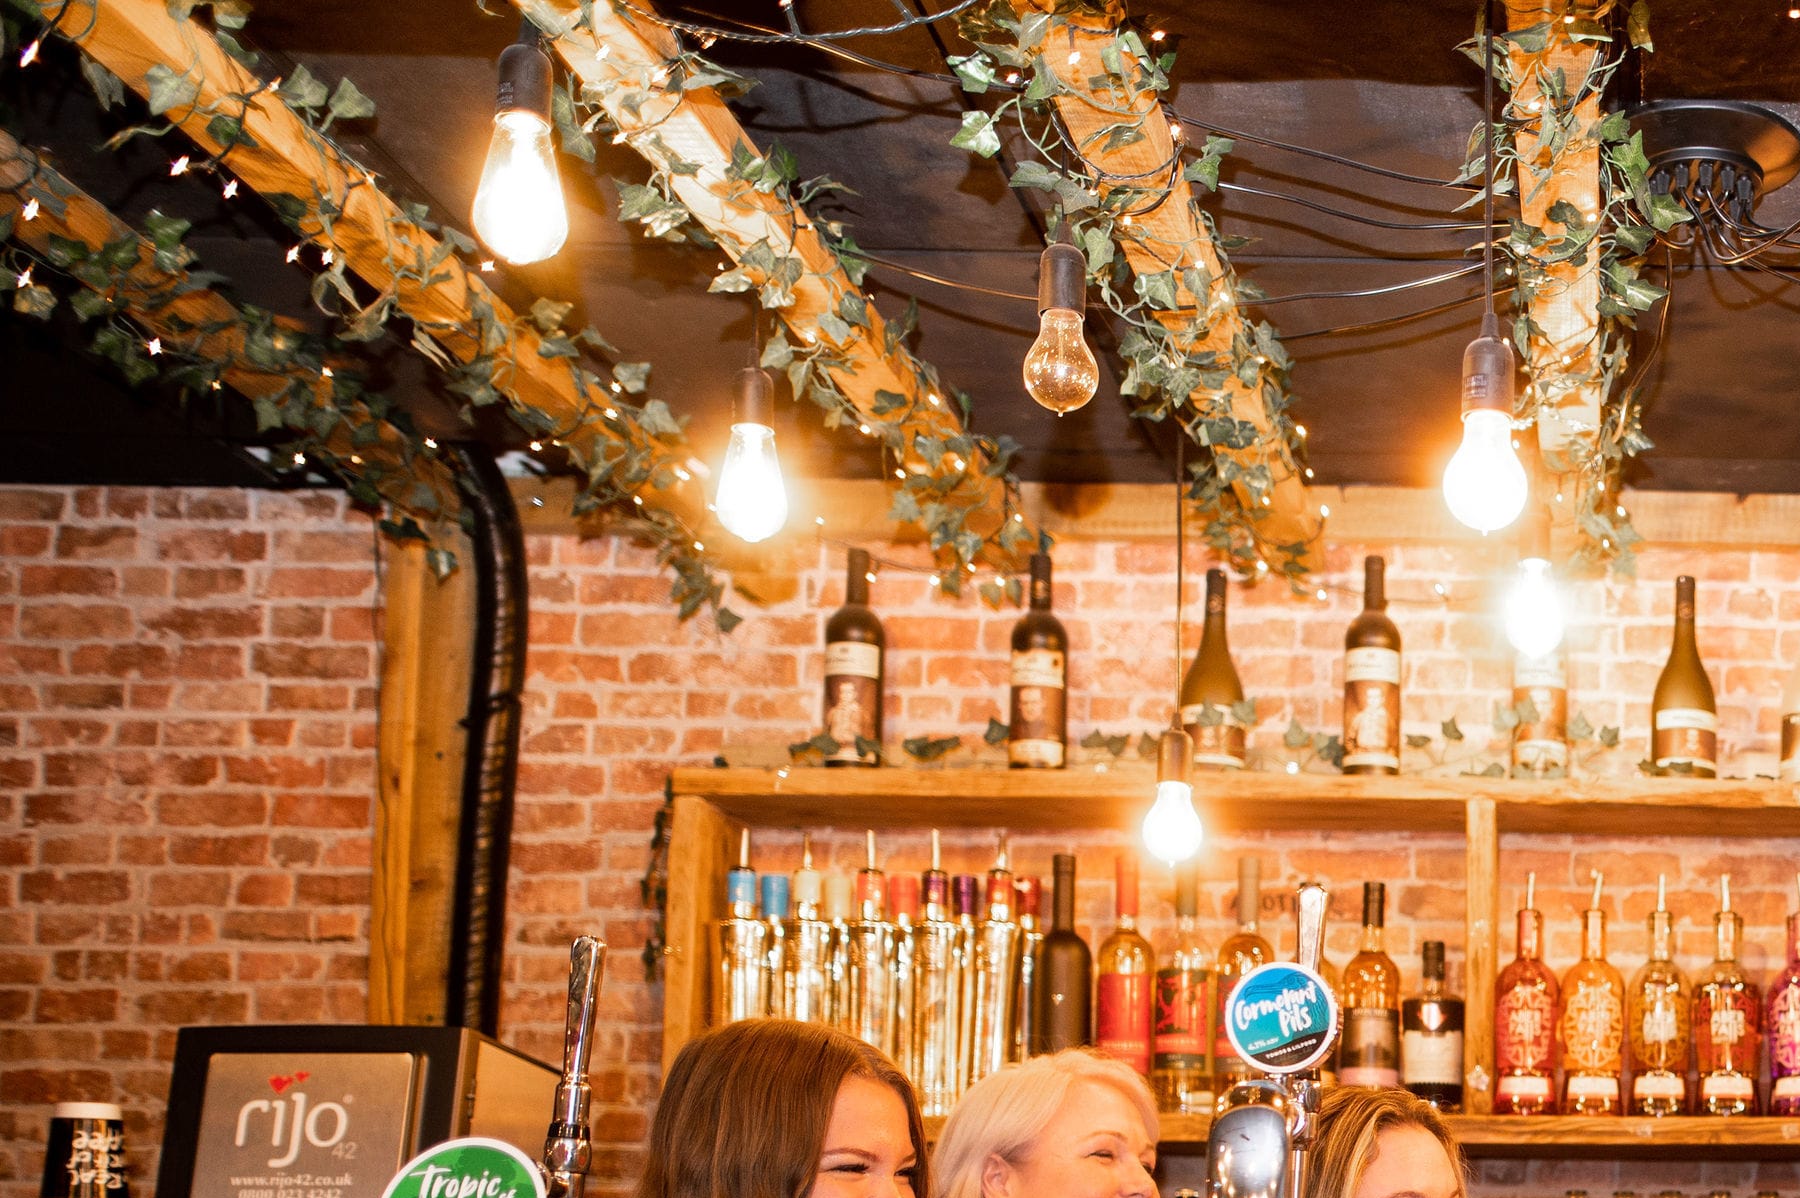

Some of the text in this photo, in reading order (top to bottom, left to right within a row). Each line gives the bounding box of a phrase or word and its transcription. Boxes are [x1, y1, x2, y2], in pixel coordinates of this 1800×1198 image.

[1279, 1004, 1312, 1037] Pils
[235, 1080, 348, 1168] rijo
[331, 1141, 357, 1160] 42
[230, 1173, 353, 1189] www.rijo42.co.uk
